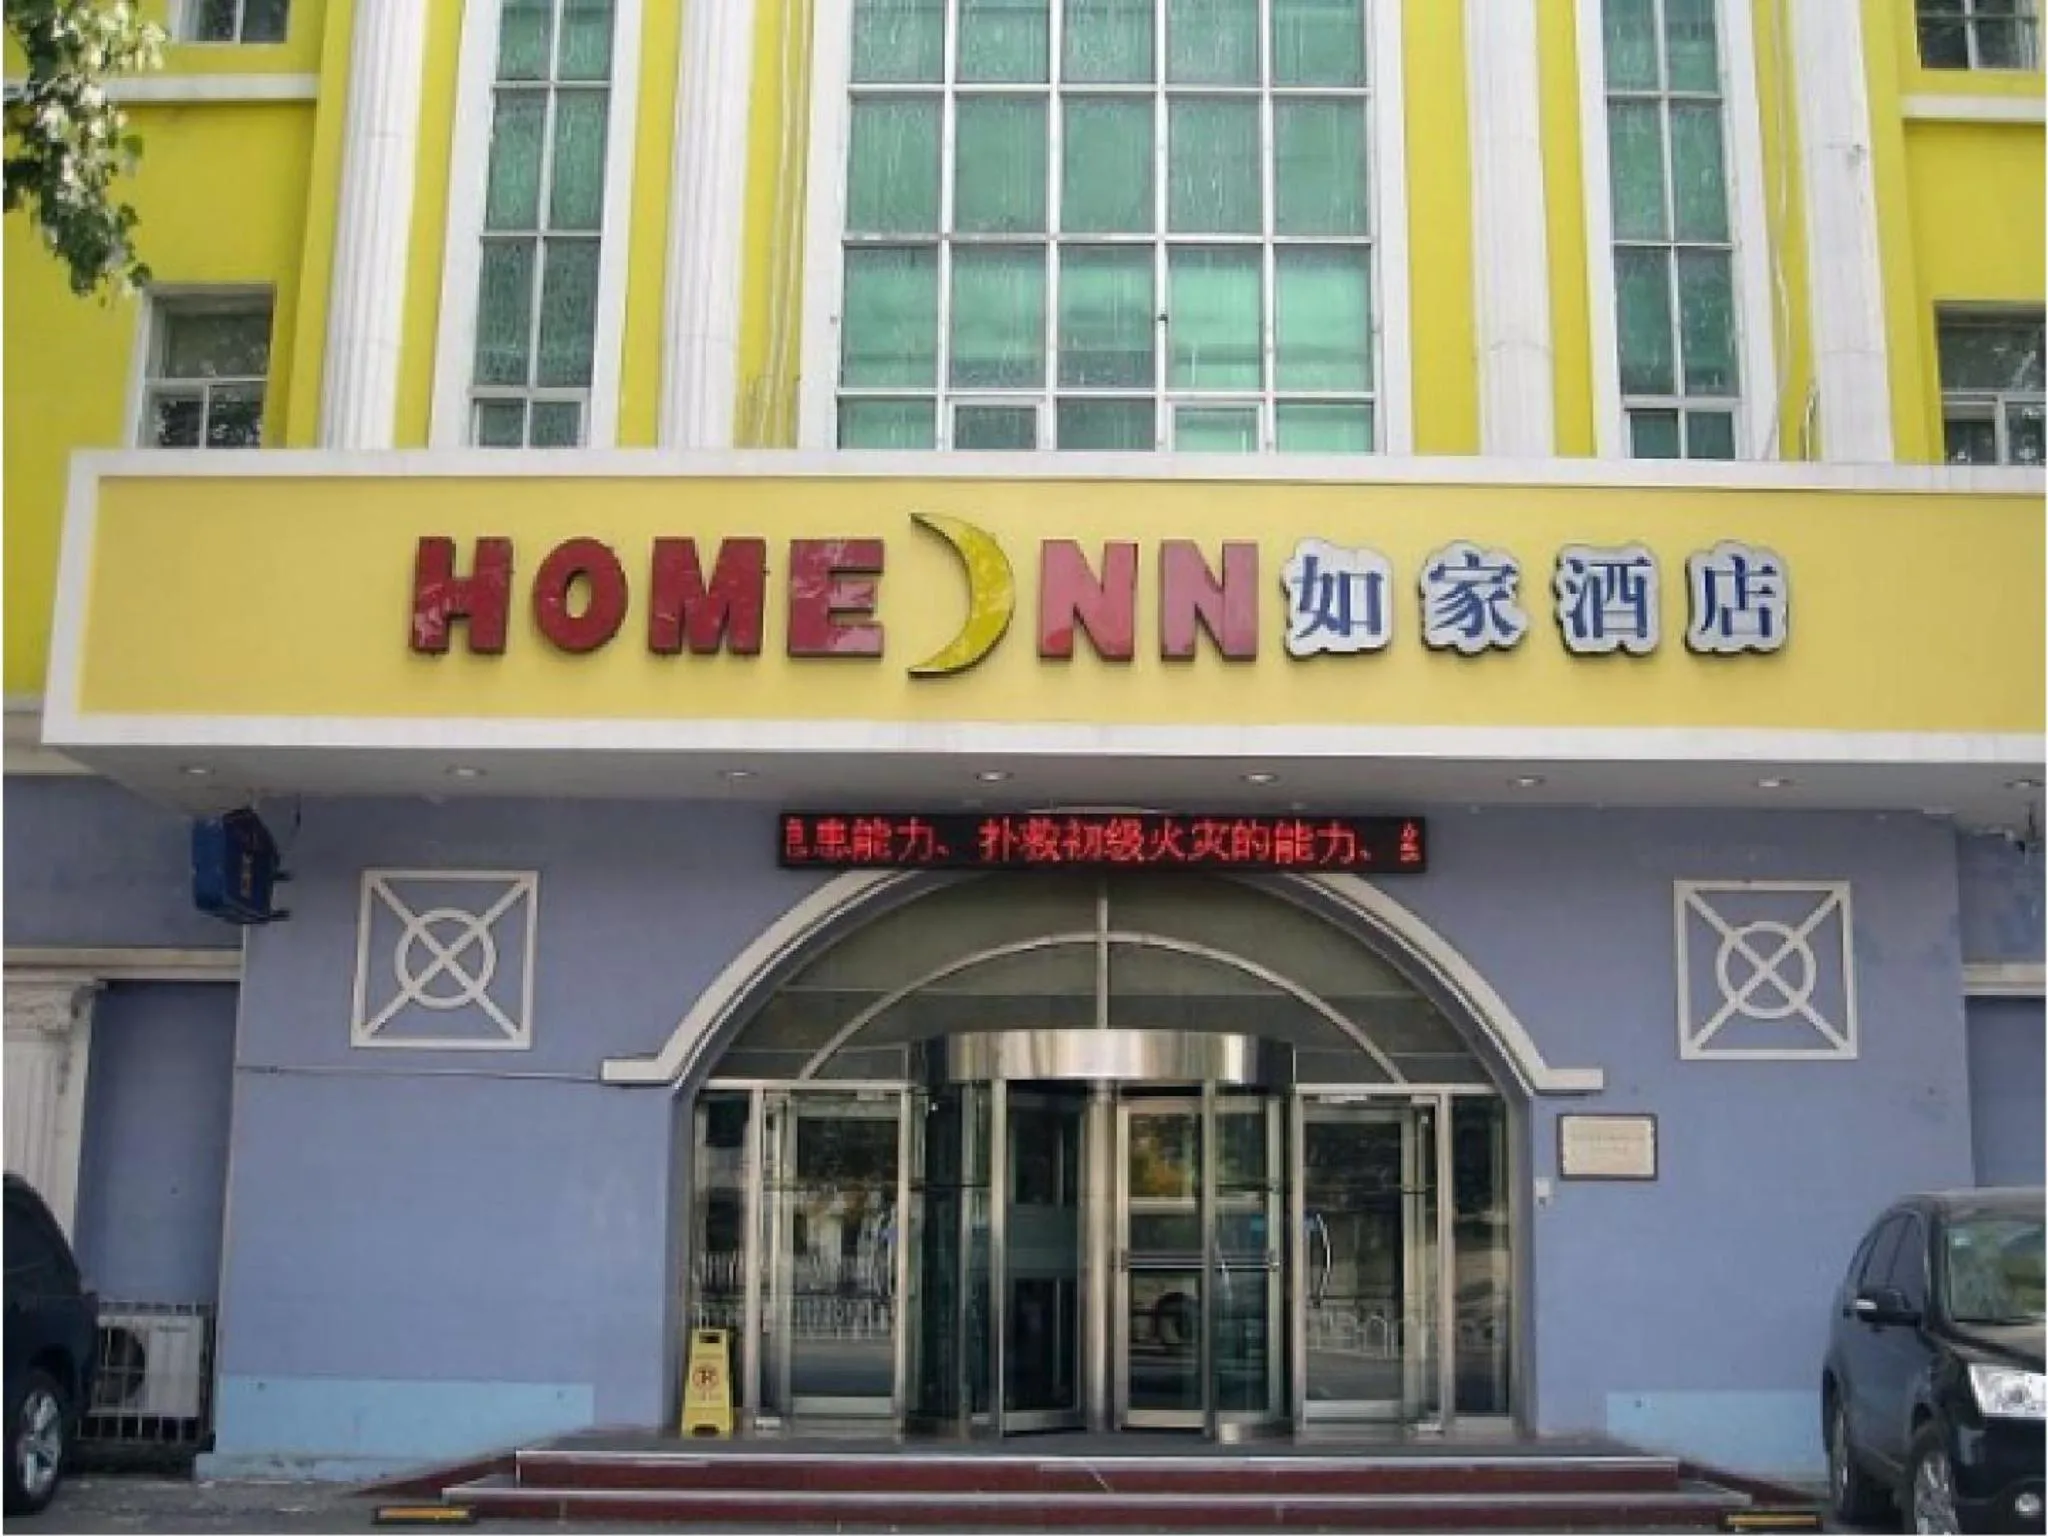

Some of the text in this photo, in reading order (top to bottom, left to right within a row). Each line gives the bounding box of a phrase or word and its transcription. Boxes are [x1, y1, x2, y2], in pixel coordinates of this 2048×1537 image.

[409, 535, 886, 657] HOME
[1290, 546, 1782, 646] 如家酒店
